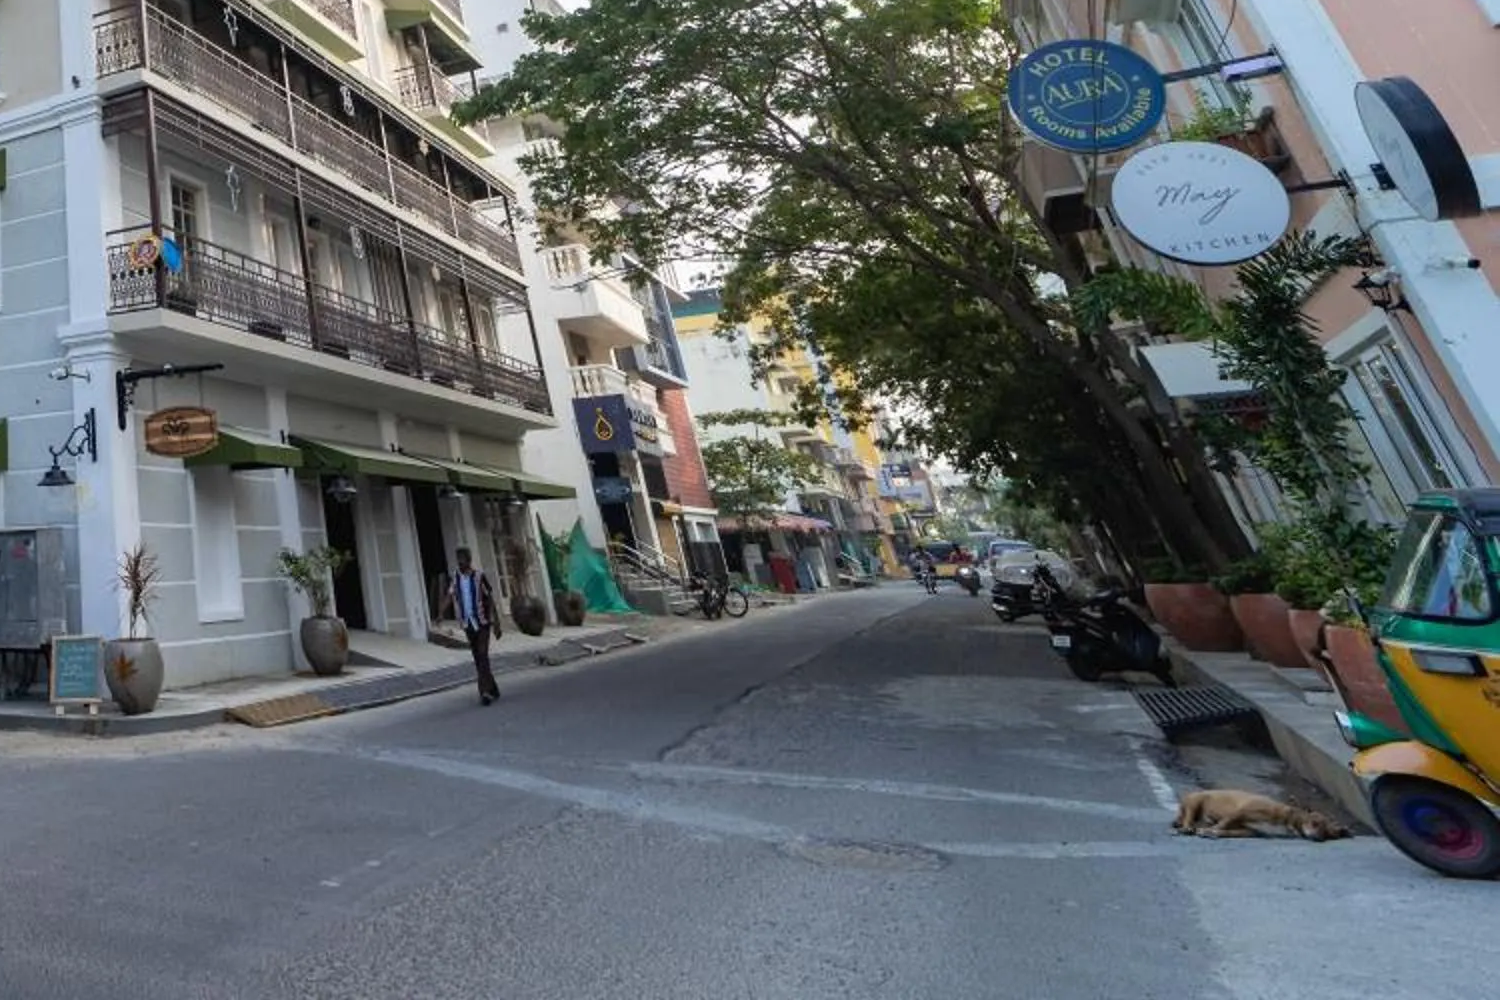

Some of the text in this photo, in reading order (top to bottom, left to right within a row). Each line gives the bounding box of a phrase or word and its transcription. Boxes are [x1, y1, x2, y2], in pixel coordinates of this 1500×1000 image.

[1028, 47, 1109, 78] HOTEL
[1028, 87, 1152, 139] Rooms Available
[1155, 180, 1242, 226] May
[1169, 232, 1269, 253] KITCHEN
